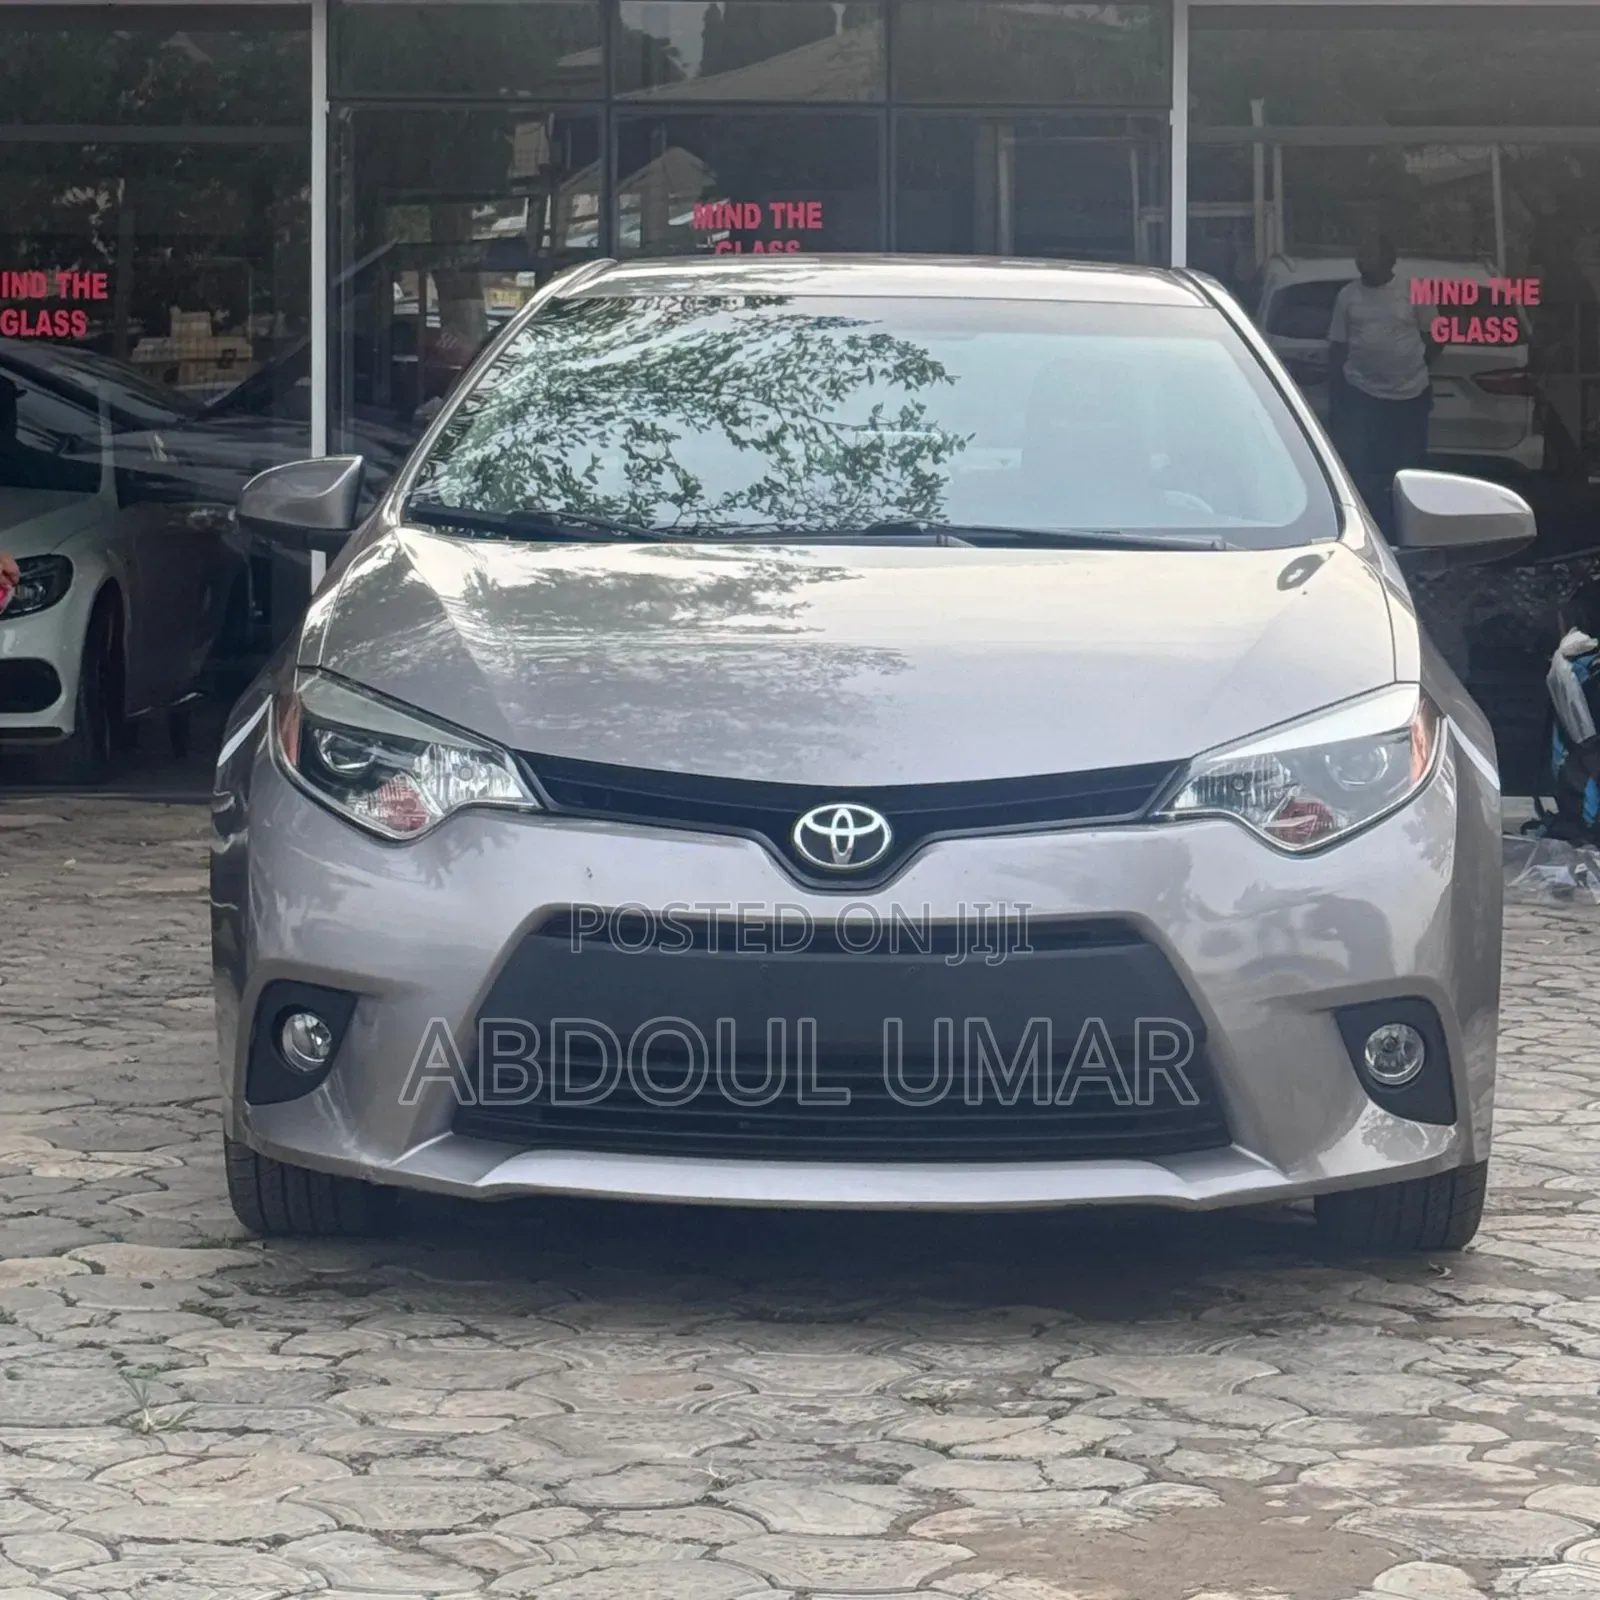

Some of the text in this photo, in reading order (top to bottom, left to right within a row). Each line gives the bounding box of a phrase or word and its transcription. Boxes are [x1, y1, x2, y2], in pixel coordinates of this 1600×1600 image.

[692, 201, 823, 230] MIND THE
[0, 271, 108, 300] IND THE
[1409, 276, 1541, 306] MIND THE
[0, 308, 88, 338] GLASS
[1430, 315, 1520, 344] GLASS
